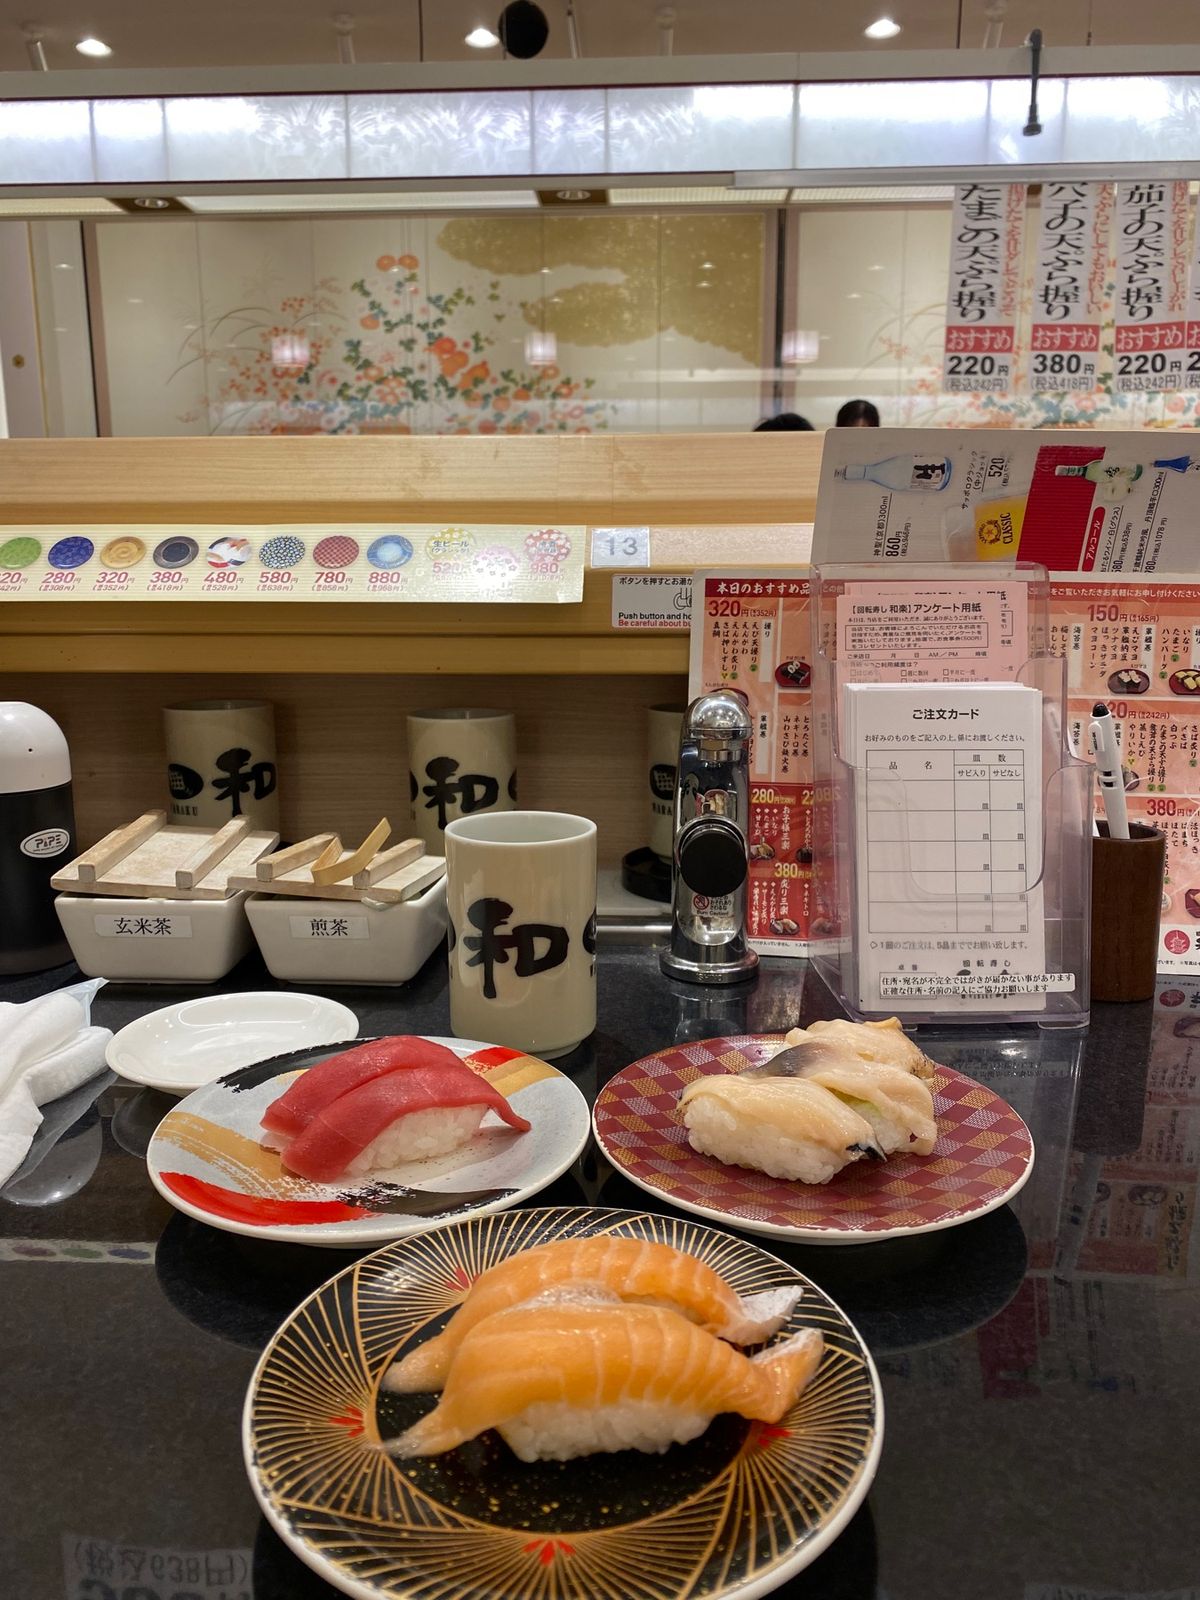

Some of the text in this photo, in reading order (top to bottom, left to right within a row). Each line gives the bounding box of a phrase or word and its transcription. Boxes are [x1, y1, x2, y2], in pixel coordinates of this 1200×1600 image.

[949, 330, 1012, 350] おすすめ
[1033, 328, 1098, 349] おすすめ
[1117, 327, 1184, 350] おすすめ
[948, 355, 1009, 376] 220円
[1033, 353, 1095, 375] 380円
[1118, 353, 1182, 375] 220円
[1000, 512, 1014, 545] CLASSIC
[605, 536, 638, 556] 13
[1085, 520, 1101, 561] アルコール
[0, 571, 408, 584] 20円 280円 320円 380円 480円 580円 780円 880円
[618, 612, 638, 621] Push
[639, 611, 665, 620] button
[666, 611, 681, 620] and
[708, 600, 750, 617] 320円
[1087, 604, 1128, 622] 150円
[618, 619, 629, 627] Be
[630, 619, 658, 627] careful
[658, 619, 681, 627] about
[741, 621, 750, 655] えんがわ
[1161, 628, 1170, 669] ハンバーグ
[1172, 628, 1180, 653] たまご
[1183, 629, 1191, 653] いなり
[912, 708, 980, 720] ご注文カード
[957, 769, 1021, 777] サビ入り サビなし
[423, 757, 500, 830] 和
[113, 916, 172, 937] 玄米茶
[309, 918, 349, 937] 煎茶
[463, 898, 570, 999] 和
